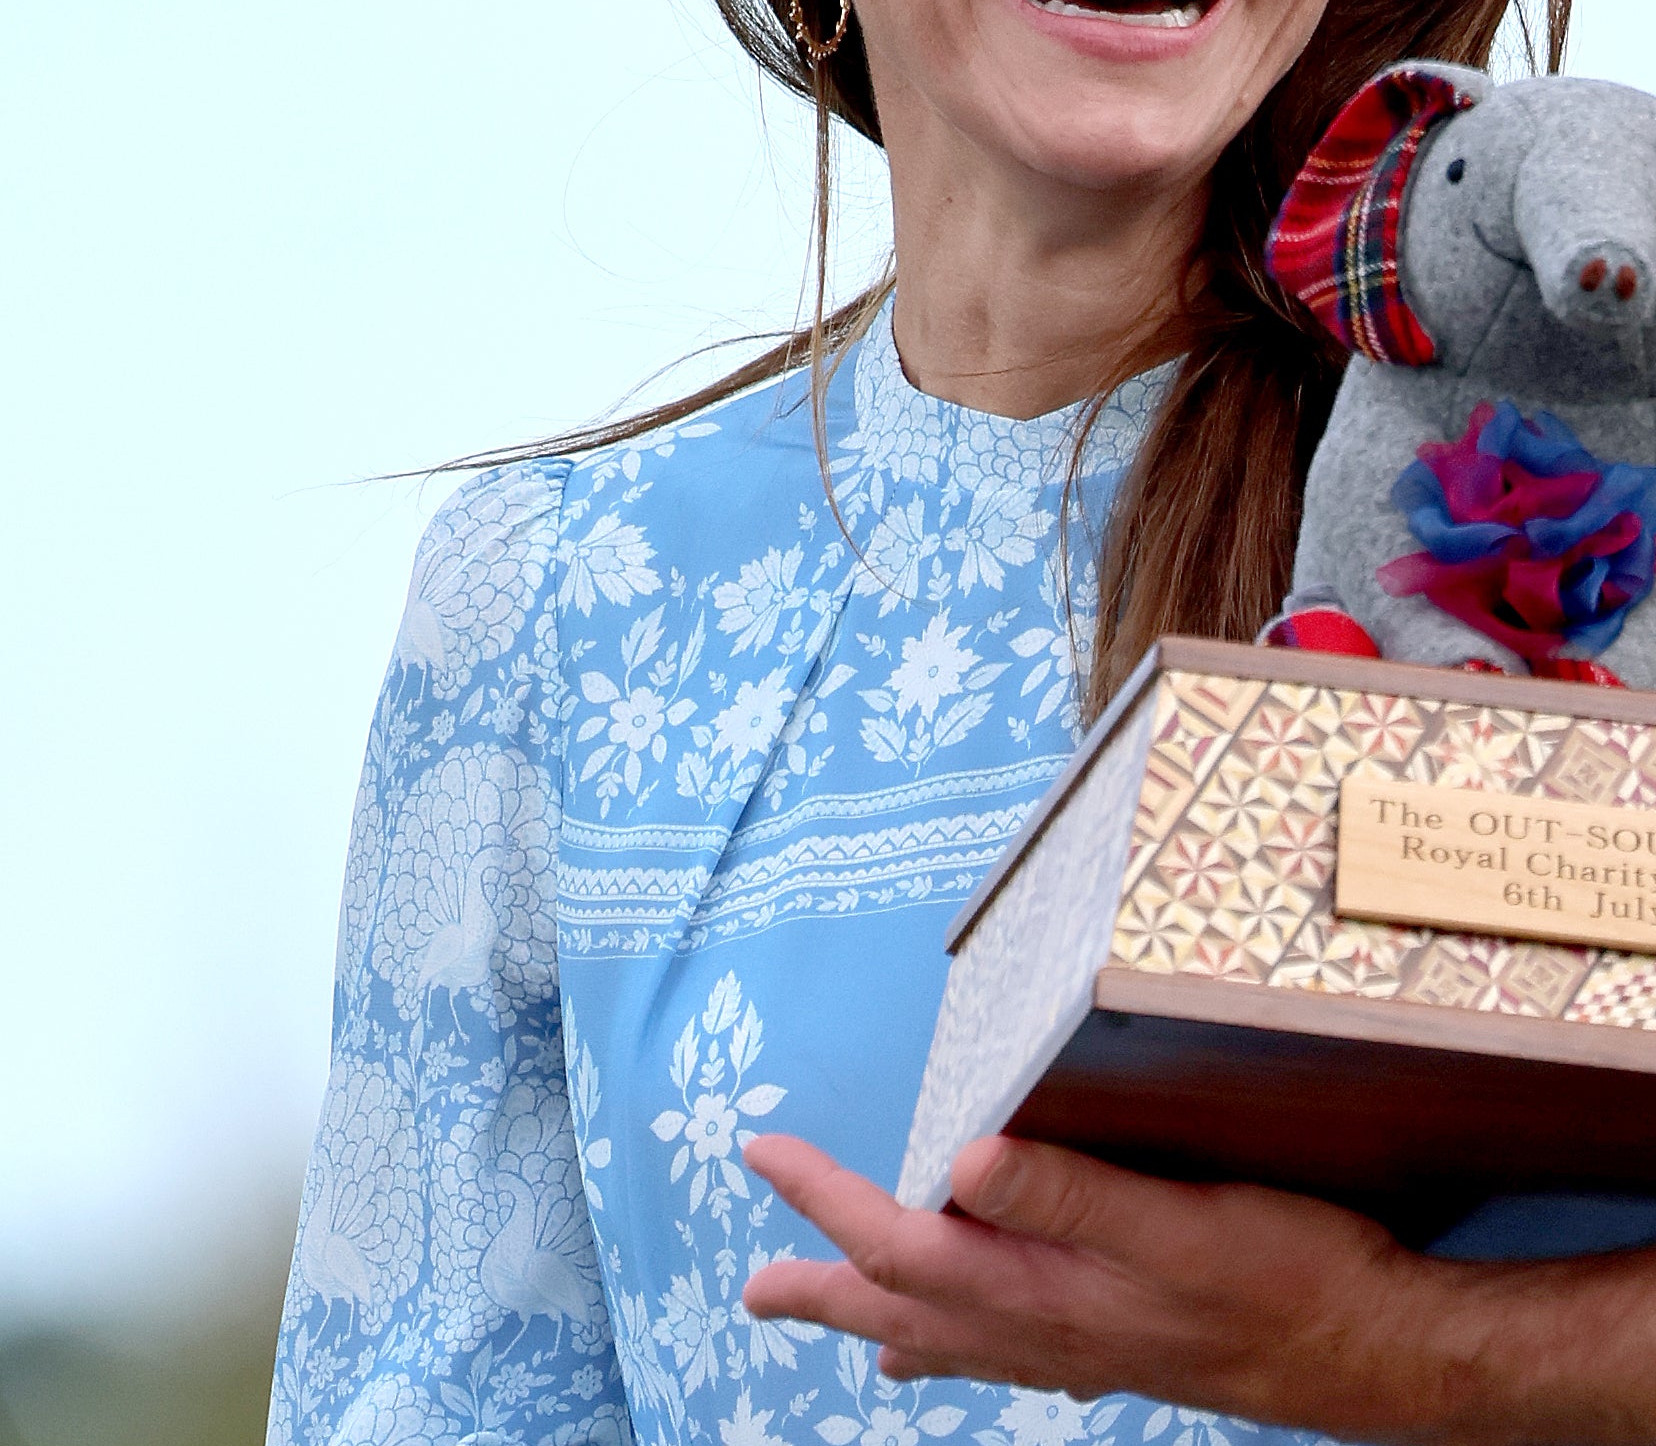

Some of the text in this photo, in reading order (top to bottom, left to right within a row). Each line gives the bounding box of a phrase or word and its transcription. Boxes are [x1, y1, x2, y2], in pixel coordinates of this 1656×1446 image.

[1370, 799, 1444, 830] The
[1401, 835, 1508, 871] Royal
[1503, 883, 1563, 912] 6th
